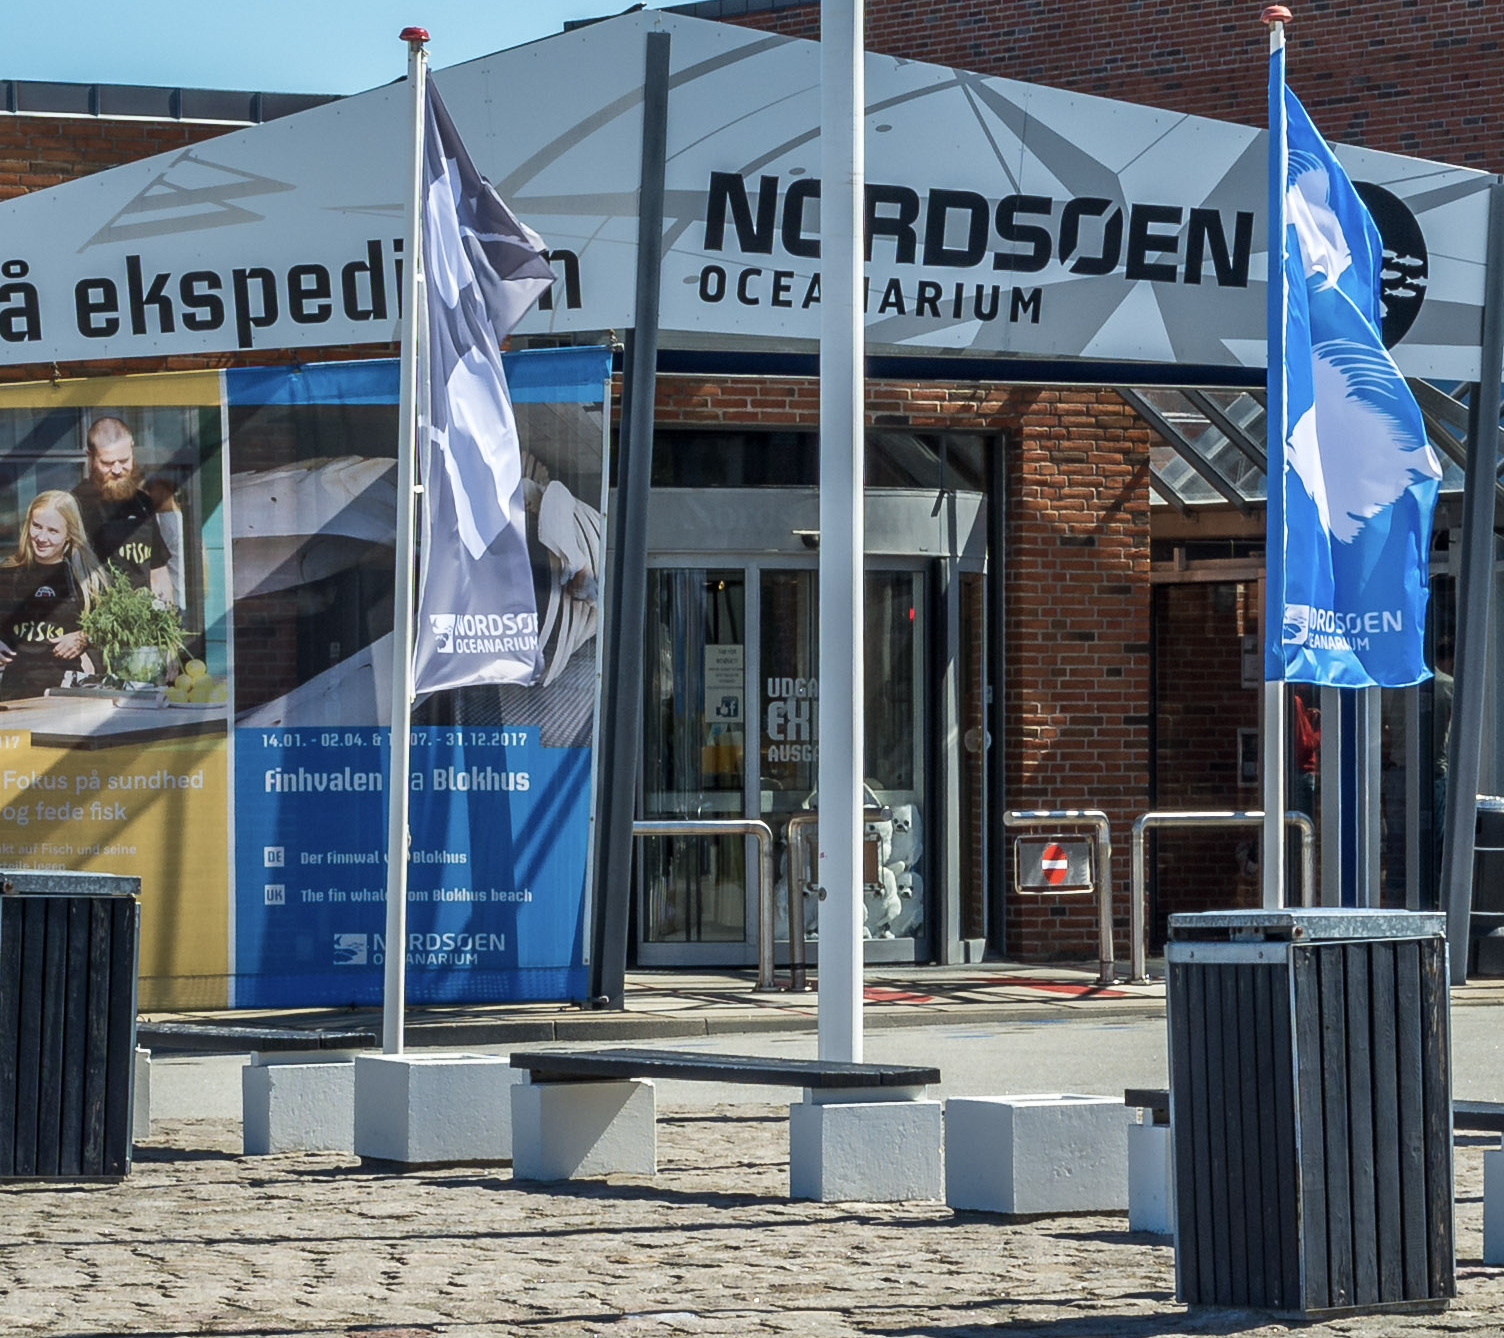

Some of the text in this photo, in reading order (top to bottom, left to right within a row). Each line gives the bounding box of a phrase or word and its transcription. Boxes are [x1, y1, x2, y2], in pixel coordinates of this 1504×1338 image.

[699, 264, 1044, 324] OCEAARIUM
[262, 733, 307, 748] 14.01.
[321, 732, 367, 747] 02.04.
[372, 732, 382, 747] &
[445, 732, 527, 747] 31.12.2017
[2, 770, 69, 791] Fokus
[75, 769, 102, 796] på
[107, 769, 204, 791] sundhed
[432, 765, 530, 792] Blokhus
[2, 801, 128, 827] og fede fisk
[18, 842, 38, 855] auf
[41, 842, 73, 856] Fisch
[77, 843, 100, 856] und
[103, 843, 137, 856] seine
[267, 850, 283, 863] DE
[300, 851, 324, 865] Der
[412, 850, 468, 864] Blokhus
[266, 888, 284, 901] UK
[300, 889, 324, 903] The
[327, 888, 347, 902] fin
[432, 887, 487, 902] Blokhus
[490, 887, 533, 903] beach
[373, 932, 506, 952] NRDSØEN
